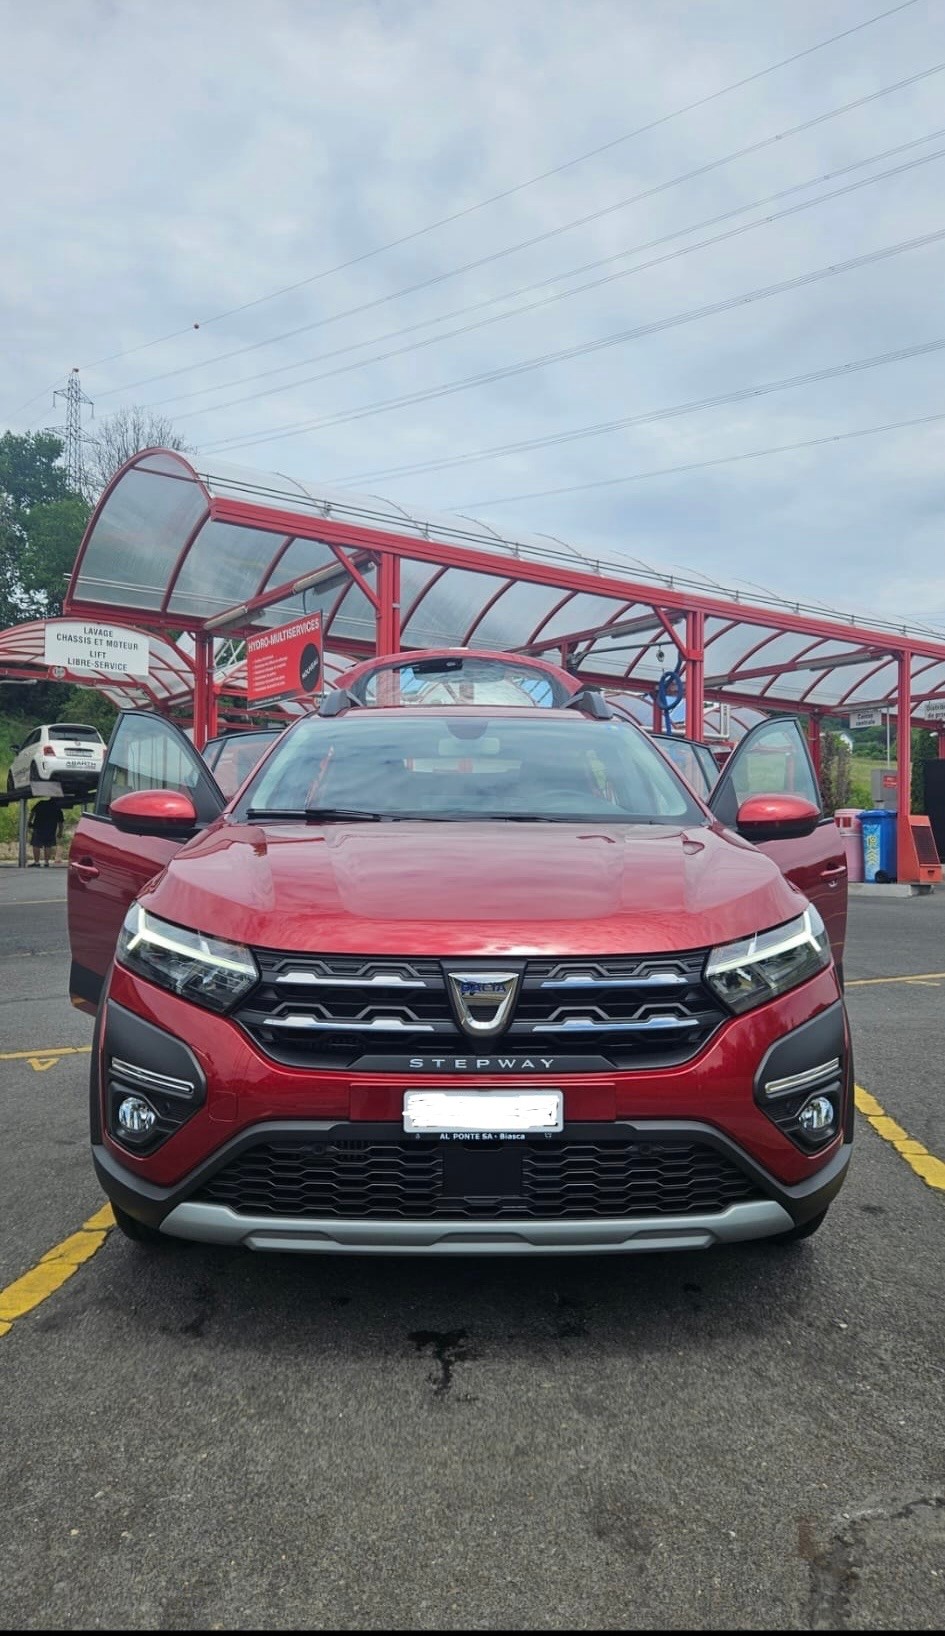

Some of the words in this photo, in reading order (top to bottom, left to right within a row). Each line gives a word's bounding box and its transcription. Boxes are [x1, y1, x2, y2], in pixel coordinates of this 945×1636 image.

[83, 626, 114, 638] LAVAGE
[248, 617, 320, 653] HYDRO-MULTISERVICES
[56, 633, 92, 645] CHASSIS
[94, 638, 103, 646] ET
[106, 640, 139, 651] MOTEUR
[89, 650, 107, 659] LIFT
[67, 657, 128, 671] LIBRE-SERVICE
[408, 1057, 555, 1069] STEPWAY
